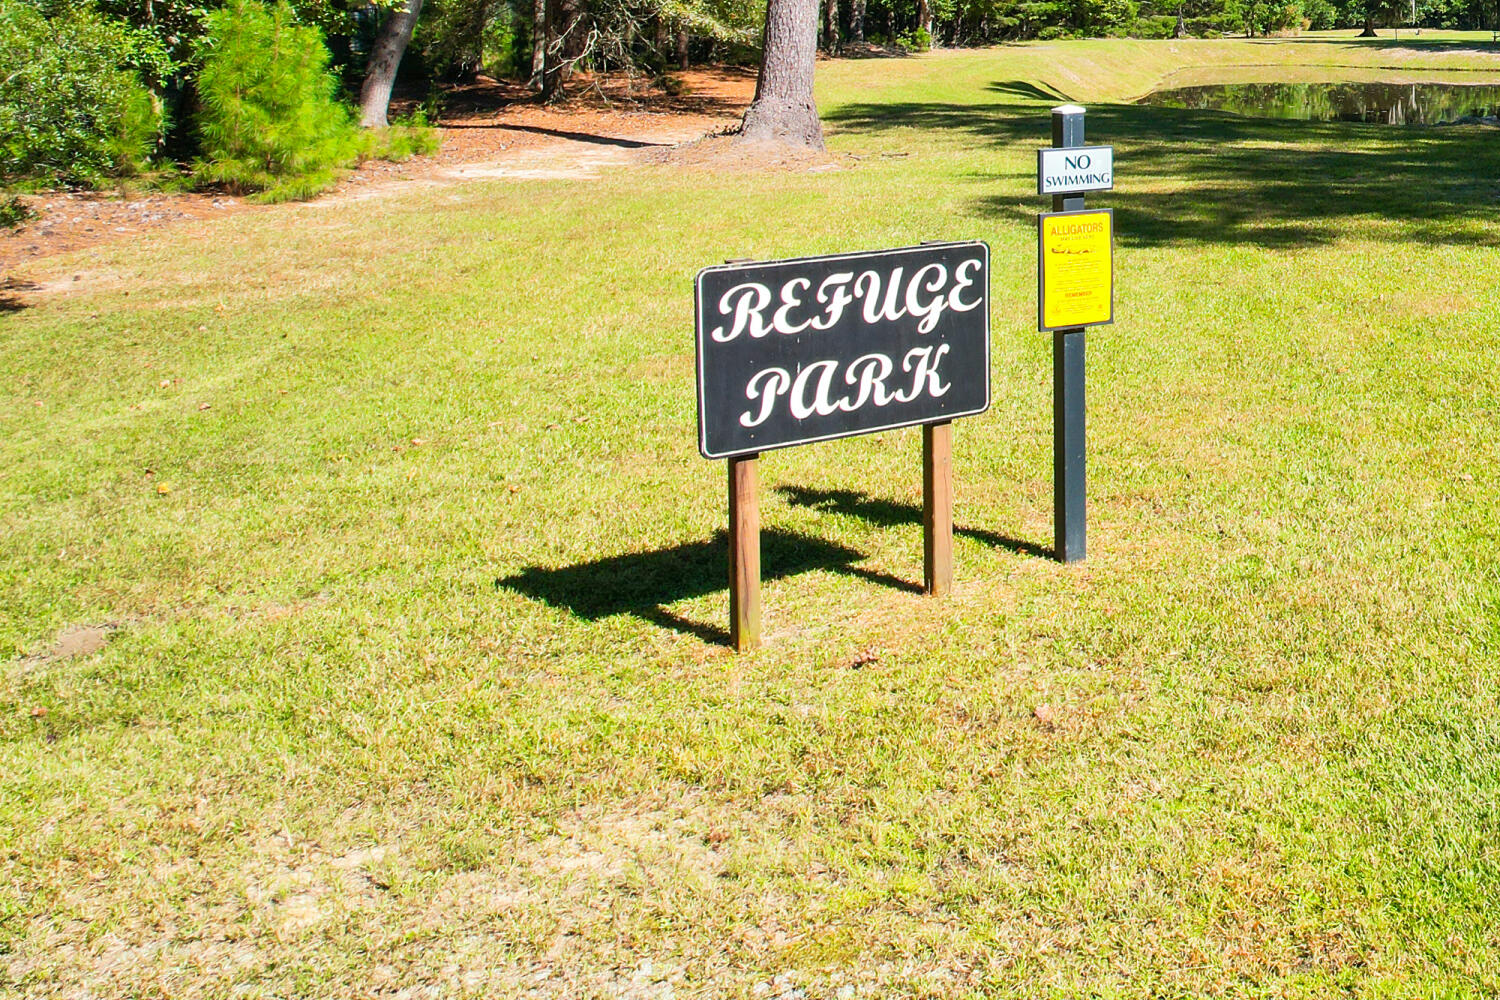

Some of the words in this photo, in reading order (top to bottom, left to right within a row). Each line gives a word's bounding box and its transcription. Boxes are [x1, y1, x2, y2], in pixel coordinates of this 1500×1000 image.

[1065, 155, 1091, 171] NO
[1045, 172, 1110, 188] SWIMMING
[1051, 222, 1103, 236] ALLIGATORS
[711, 259, 983, 343] REFUGE
[739, 343, 952, 428] PARK
